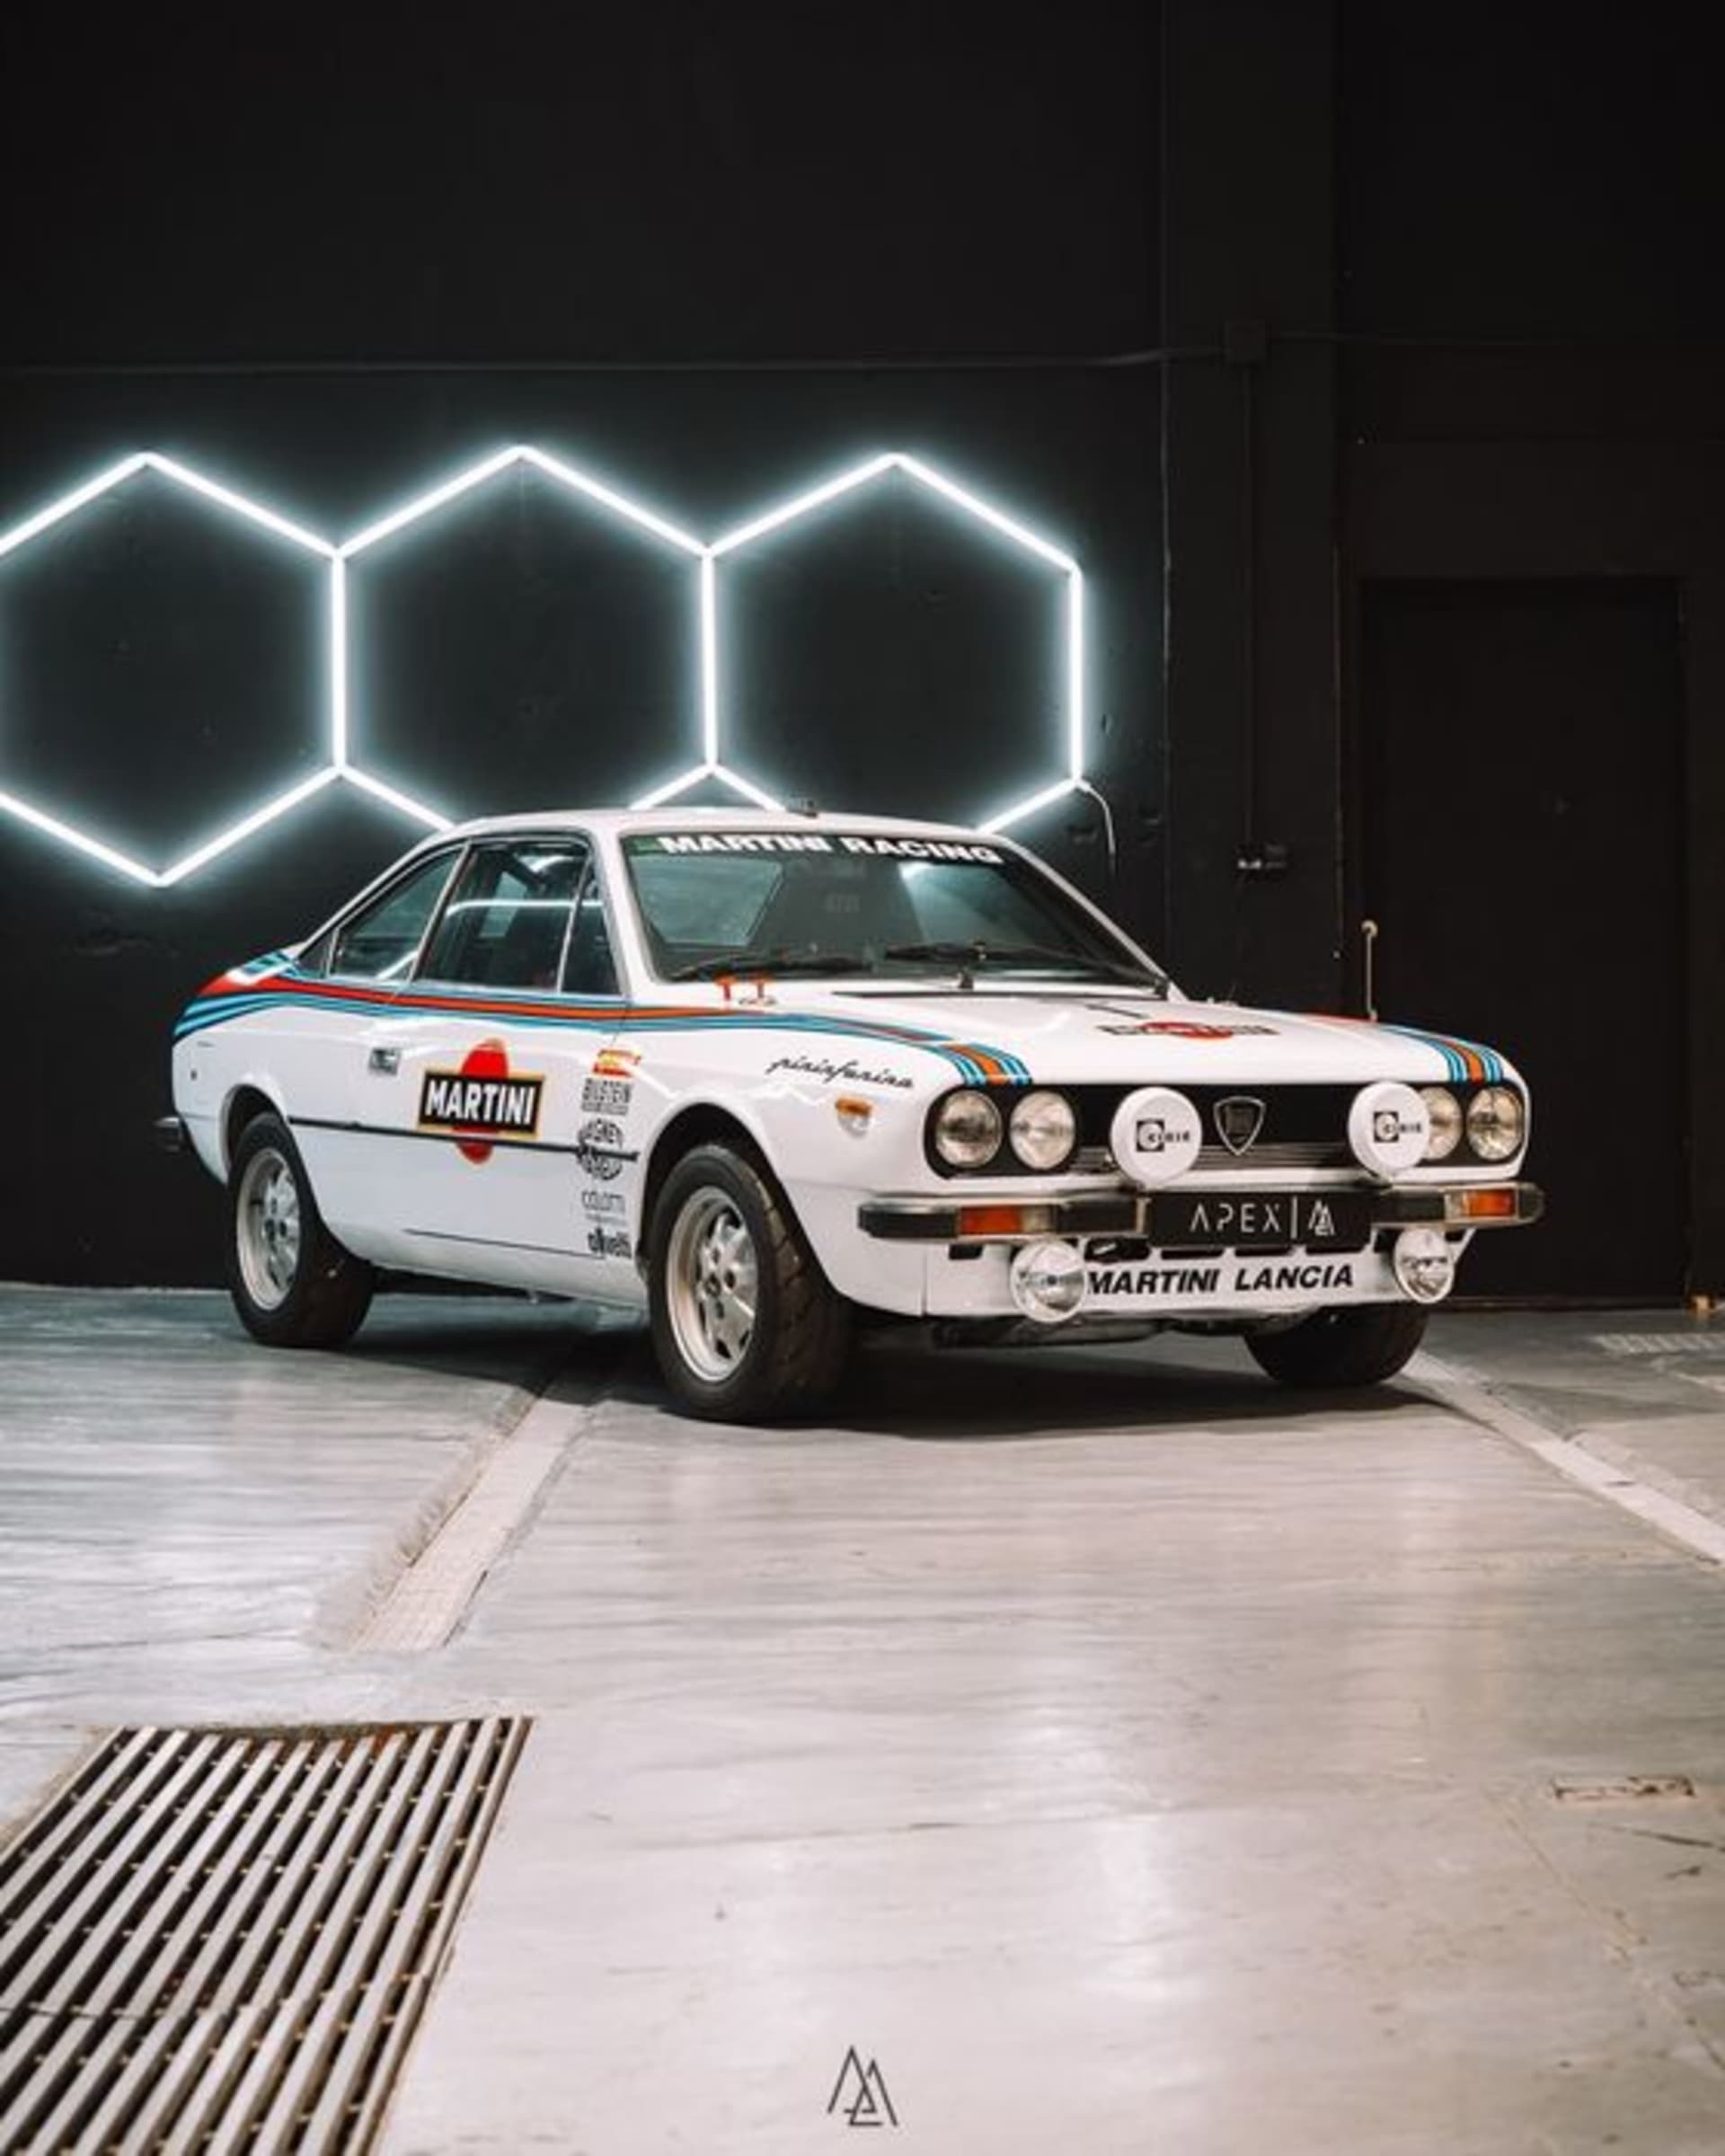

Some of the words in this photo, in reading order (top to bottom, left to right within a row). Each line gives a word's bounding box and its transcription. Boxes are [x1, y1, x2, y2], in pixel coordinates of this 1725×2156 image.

[656, 835, 832, 854] MARTINI
[838, 836, 1004, 864] RACING
[424, 1079, 536, 1126] MARTINI
[1087, 1268, 1220, 1294] MARTINI
[1234, 1264, 1354, 1292] LANCIA
